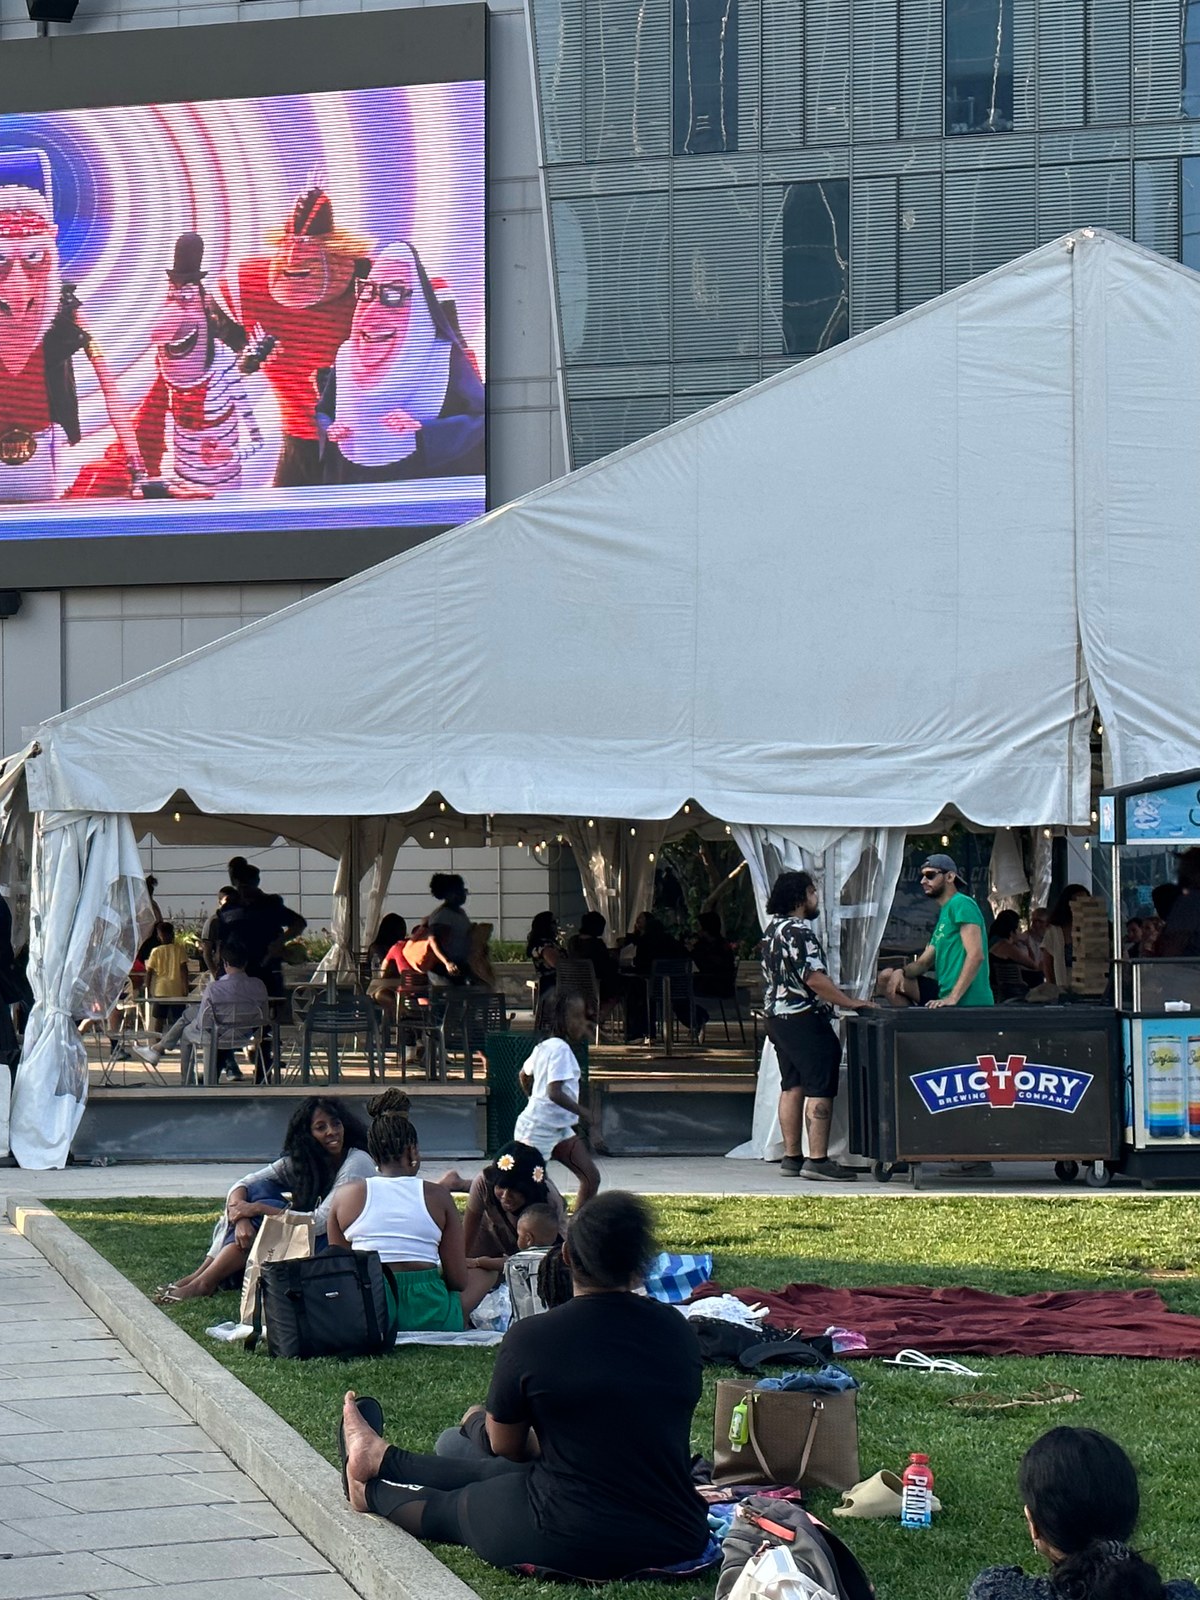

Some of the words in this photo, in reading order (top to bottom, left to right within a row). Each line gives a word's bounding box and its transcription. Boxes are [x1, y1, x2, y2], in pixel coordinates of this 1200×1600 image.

[926, 1070, 1080, 1097] VICTORY
[938, 1092, 986, 1106] BREWING
[1018, 1091, 1069, 1105] COMPANY
[906, 1474, 928, 1523] PRIME
